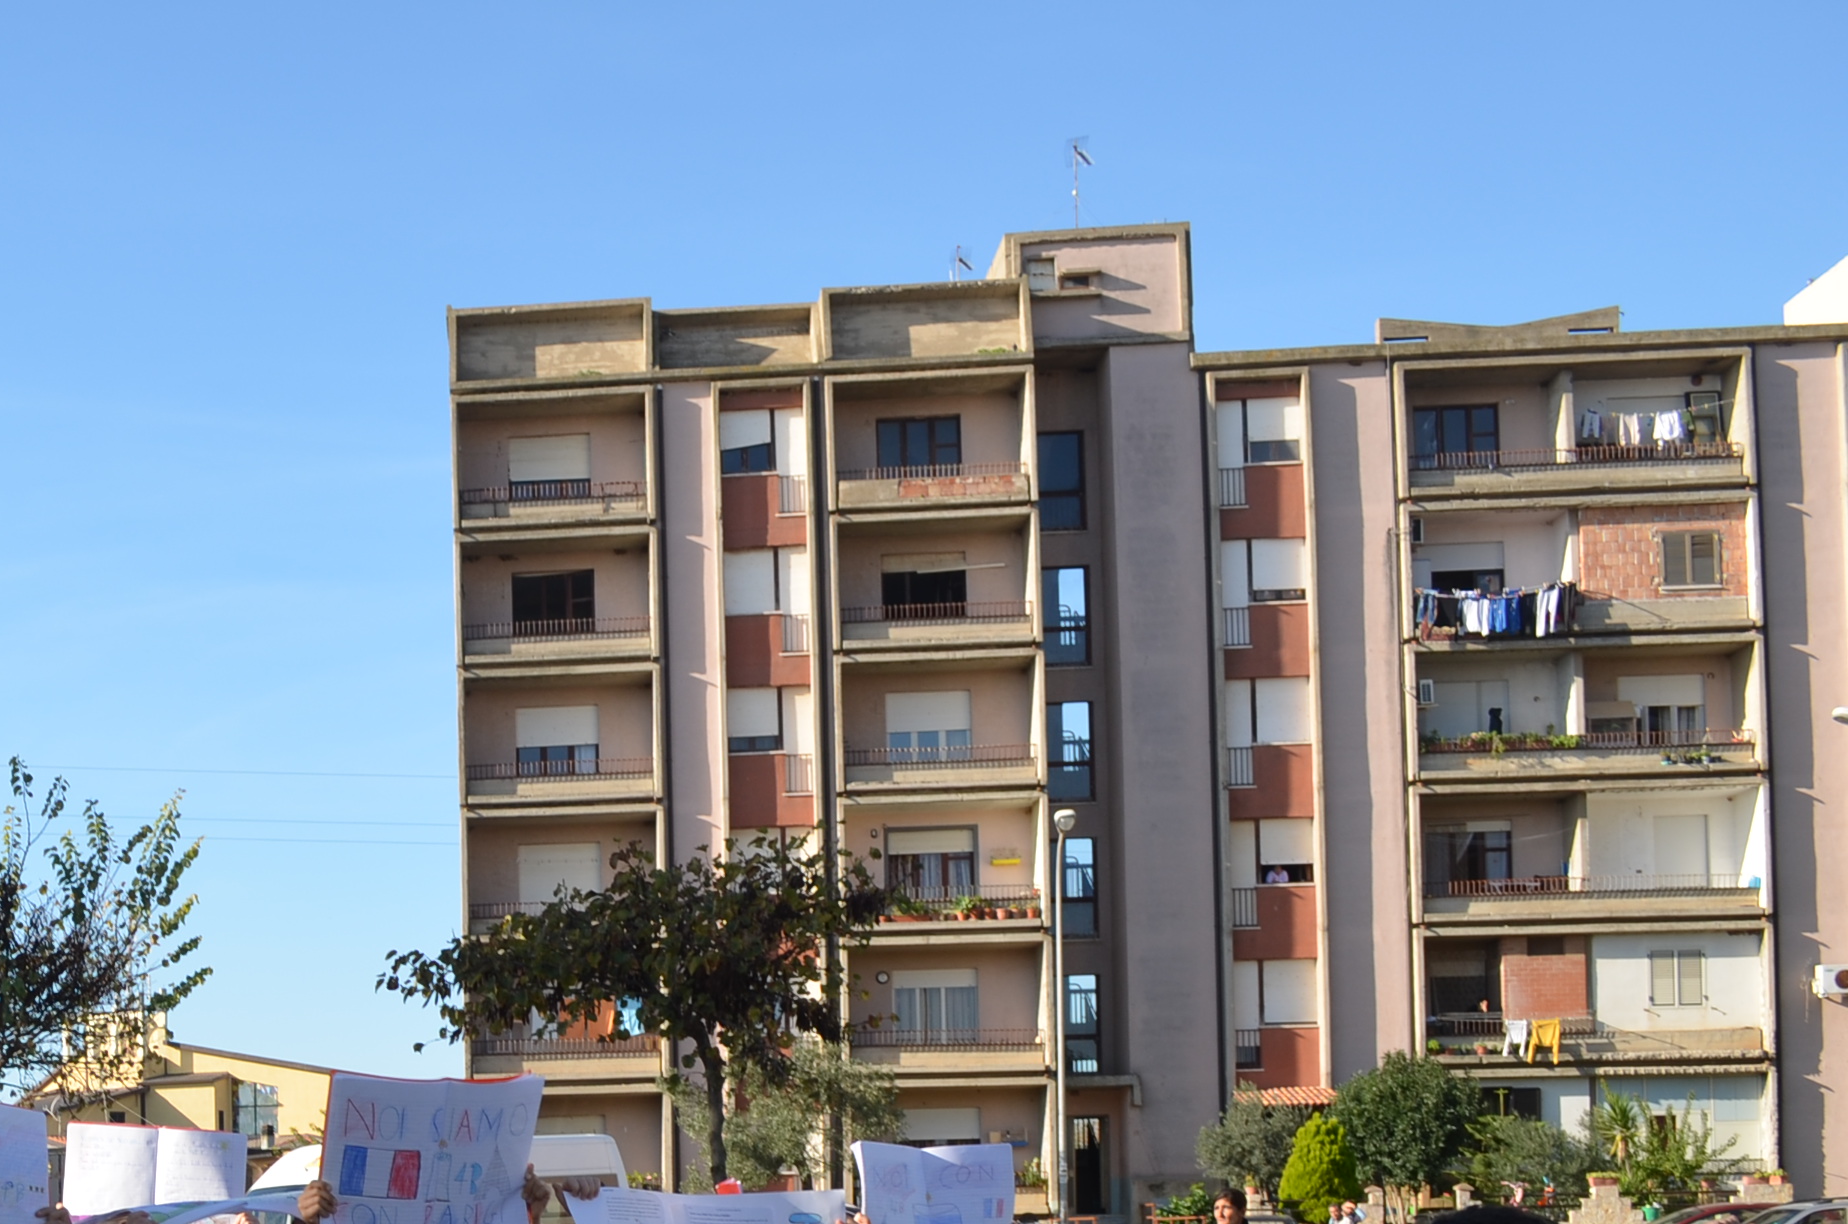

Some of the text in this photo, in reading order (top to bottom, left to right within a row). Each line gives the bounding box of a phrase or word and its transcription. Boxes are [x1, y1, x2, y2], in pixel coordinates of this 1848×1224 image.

[343, 1098, 528, 1143] NOI SIAMO
[939, 1164, 994, 1189] CON
